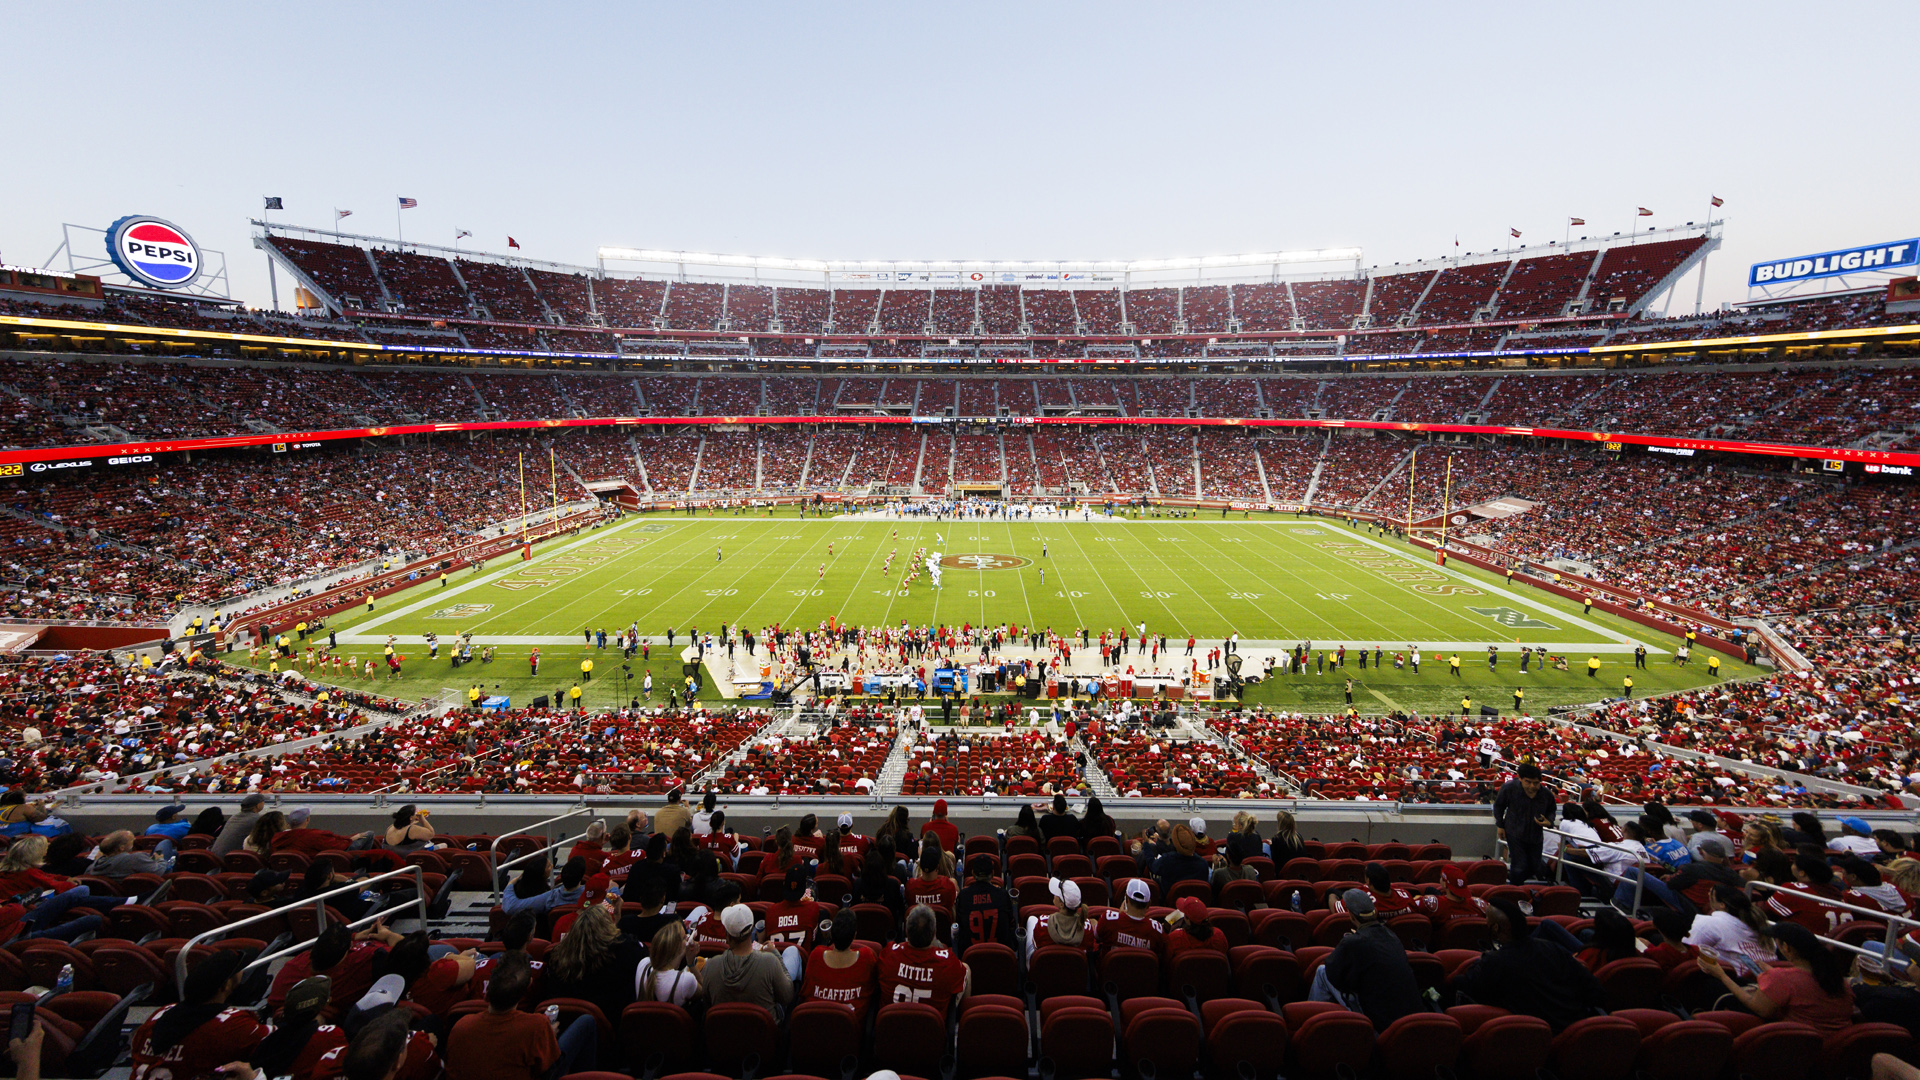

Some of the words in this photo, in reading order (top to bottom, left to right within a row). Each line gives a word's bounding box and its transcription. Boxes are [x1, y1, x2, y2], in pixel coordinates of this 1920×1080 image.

[128, 241, 193, 263] PEPSI
[1756, 260, 1813, 281] BUD
[1814, 245, 1909, 274] LIGHT
[48, 461, 92, 469] LEXUS
[108, 455, 153, 465] GEICO
[1830, 461, 1841, 470] 15
[1881, 464, 1912, 475] bank
[490, 538, 650, 591] 49ERS
[1314, 541, 1488, 596] 49ERS
[622, 588, 653, 597] 10
[705, 588, 739, 597] 20
[793, 589, 824, 597] 30
[880, 589, 909, 597] 40
[1054, 590, 1084, 598] 40
[1140, 590, 1171, 599] 30
[1226, 591, 1259, 600] 20
[1315, 592, 1348, 601] 10
[915, 894, 942, 904] KITTLE
[973, 894, 993, 905] BOSA
[778, 915, 799, 928] BOSA
[969, 908, 999, 944] 97
[1117, 932, 1151, 949] HUFANGA
[897, 962, 934, 982] KITTLE
[814, 985, 862, 1001] McCAFFREY
[140, 1037, 184, 1062] SAEL
